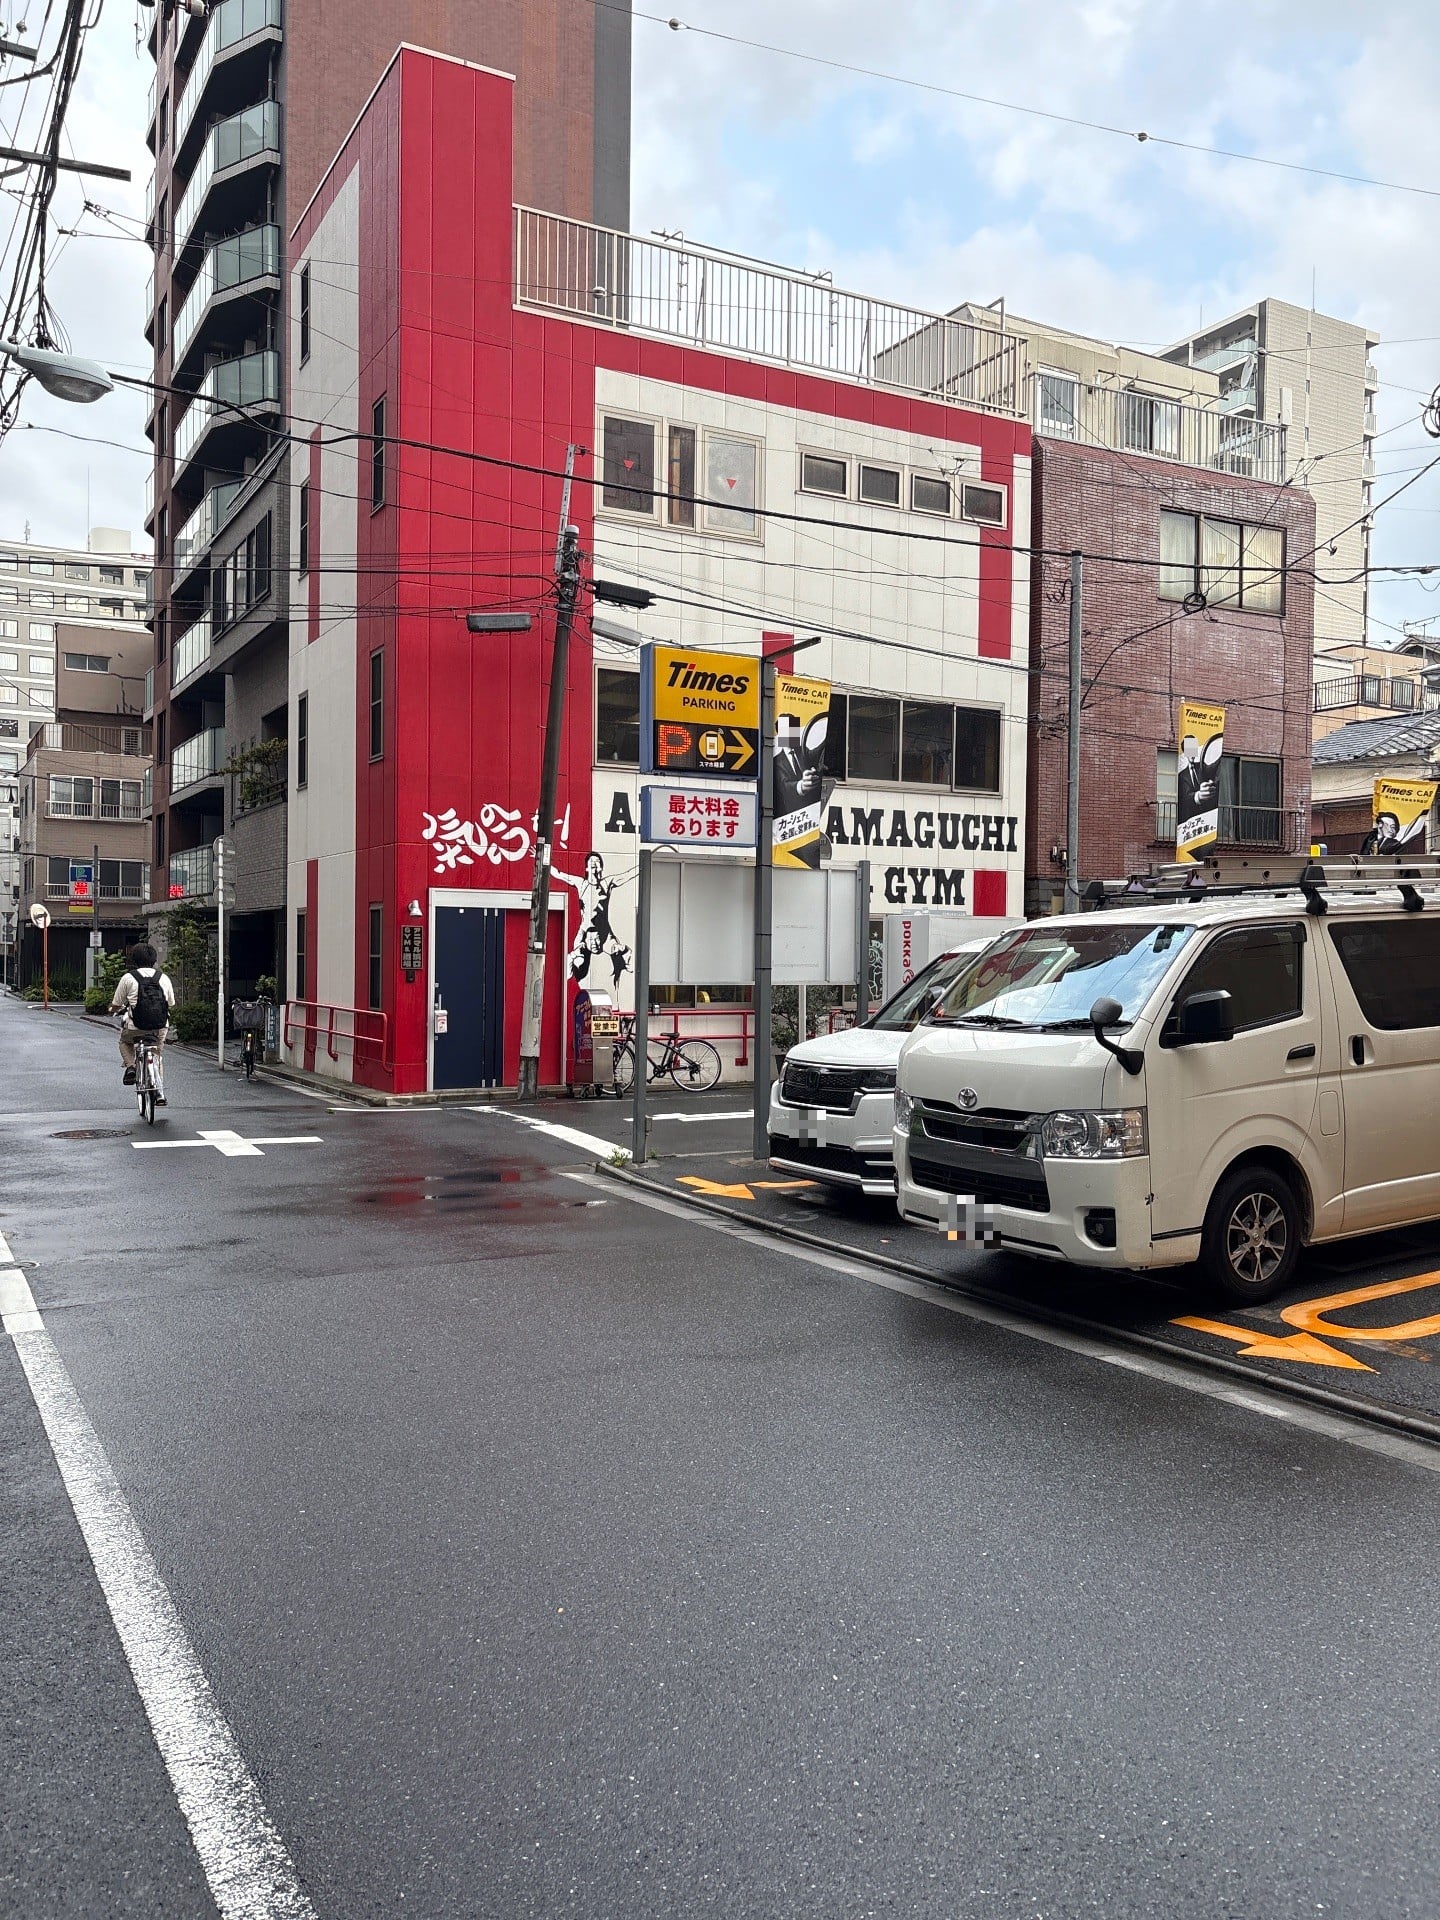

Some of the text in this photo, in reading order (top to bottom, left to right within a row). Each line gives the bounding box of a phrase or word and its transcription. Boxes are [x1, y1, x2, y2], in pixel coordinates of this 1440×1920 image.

[668, 661, 749, 694] Times
[781, 683, 828, 699] Times CAR
[683, 697, 736, 711] PARKING
[1185, 709, 1207, 719] Times
[658, 724, 692, 766] P
[1381, 785, 1413, 796] Times
[669, 795, 740, 818] 最大料金
[605, 792, 1018, 852] A AMAGUCHI
[669, 817, 739, 838] あります
[884, 867, 965, 905] GYM
[902, 920, 912, 967] pokka
[593, 1022, 618, 1031] 営業中
